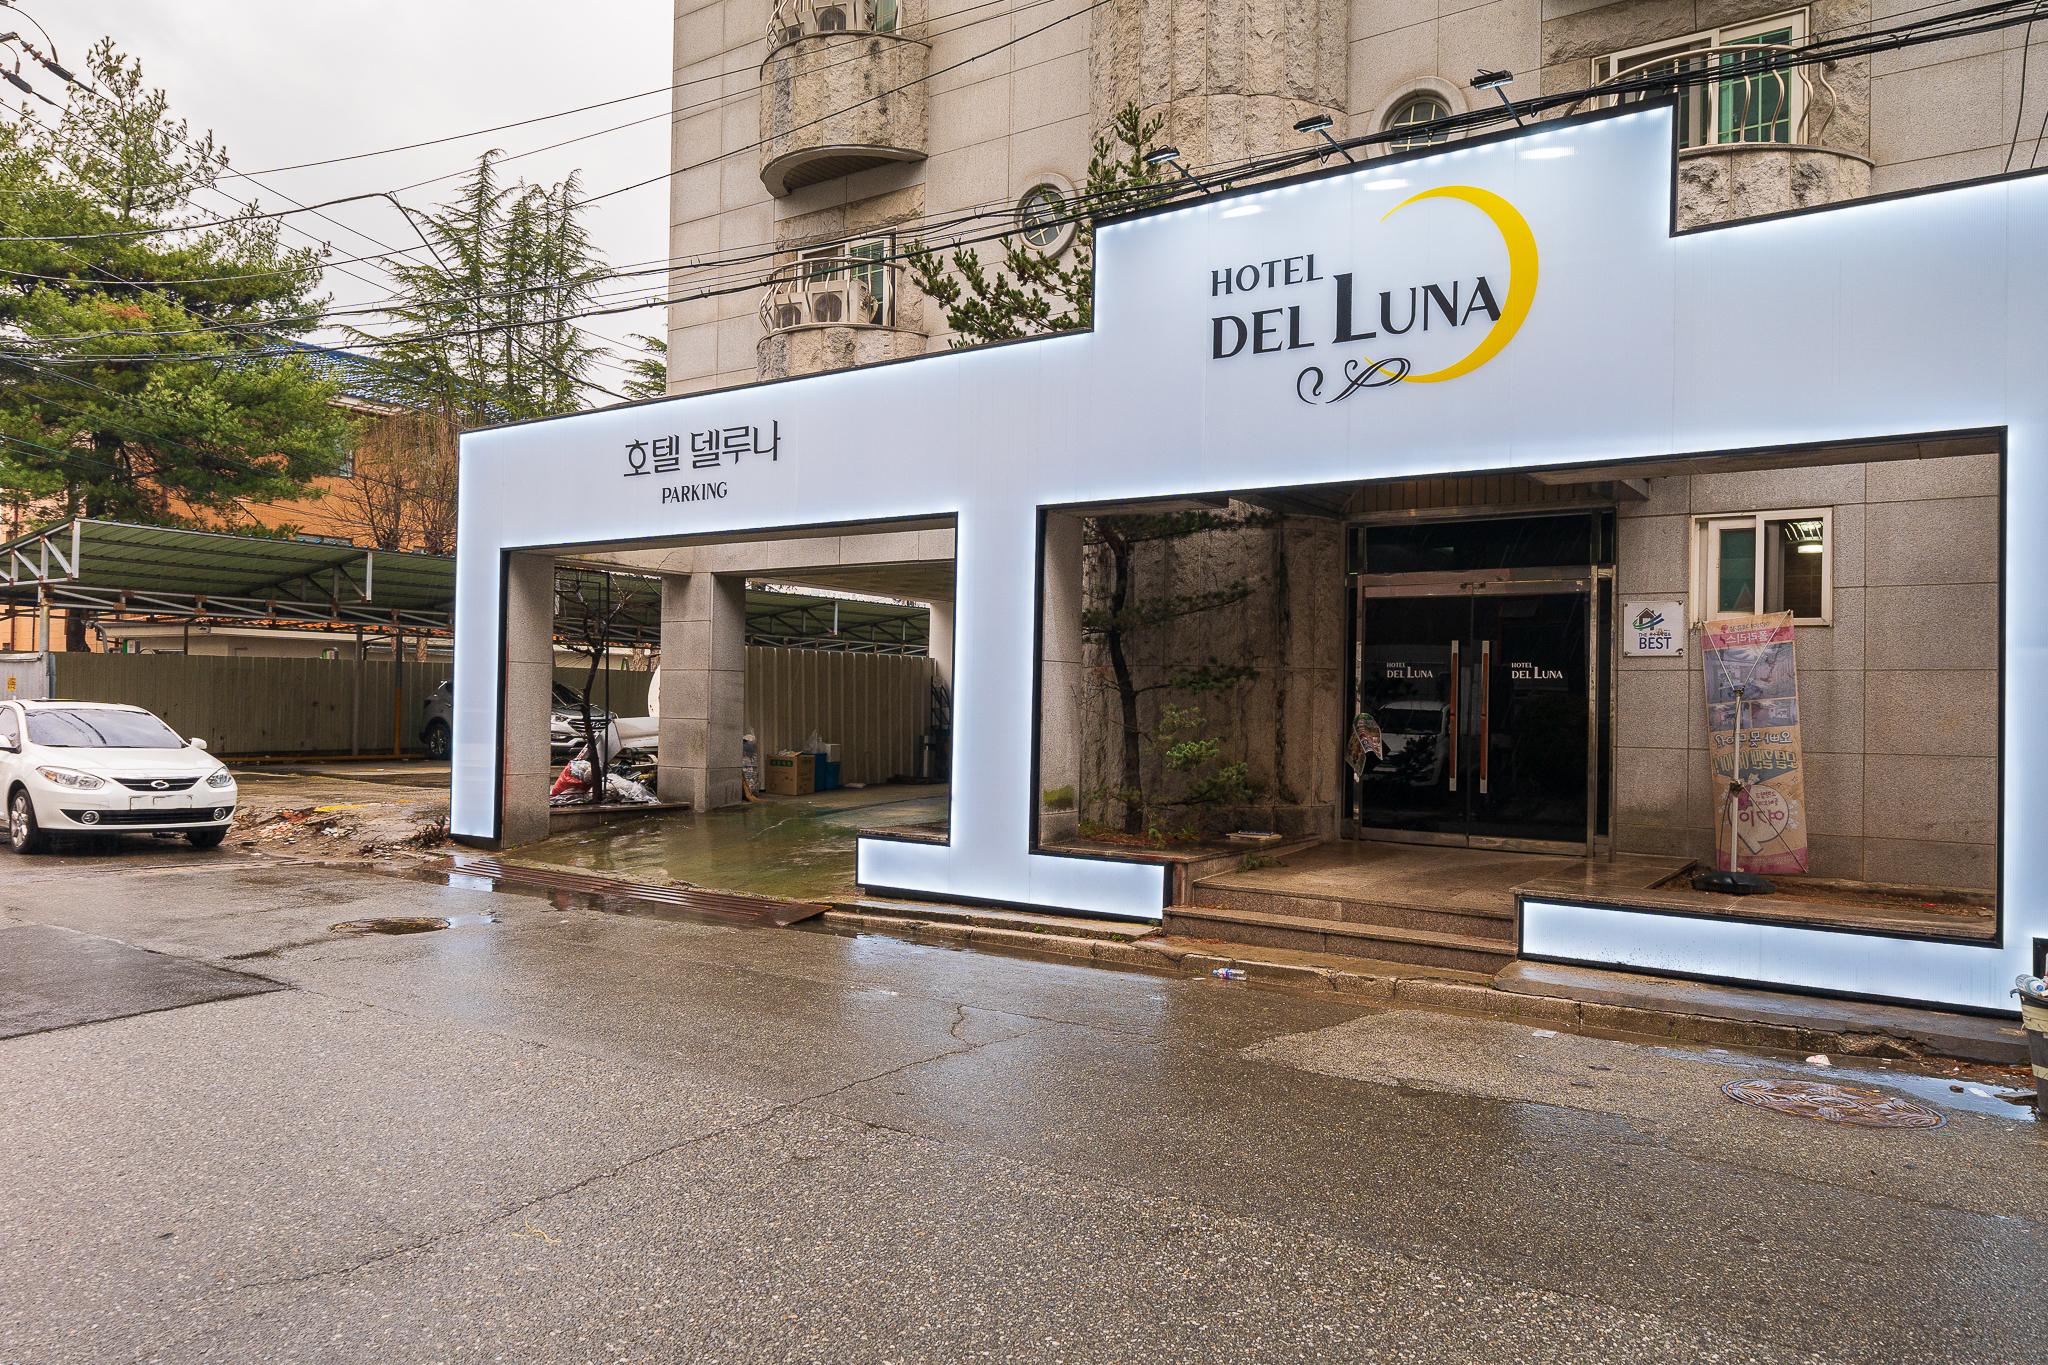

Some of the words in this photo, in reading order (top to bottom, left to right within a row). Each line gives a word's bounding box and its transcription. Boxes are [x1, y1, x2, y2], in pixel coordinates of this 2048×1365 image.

[1211, 253, 1324, 297] HOTEL
[1211, 304, 1315, 360] DEL
[1332, 272, 1502, 345] LUNA
[623, 434, 681, 478] 호텔
[690, 419, 782, 470] 델루나
[661, 481, 728, 504] PARKING
[1639, 637, 1672, 650] BEST
[1386, 669, 1405, 678] DEL
[1406, 666, 1433, 678] LUNA
[1511, 670, 1532, 679] DEL
[1534, 666, 1563, 679] LUNA
